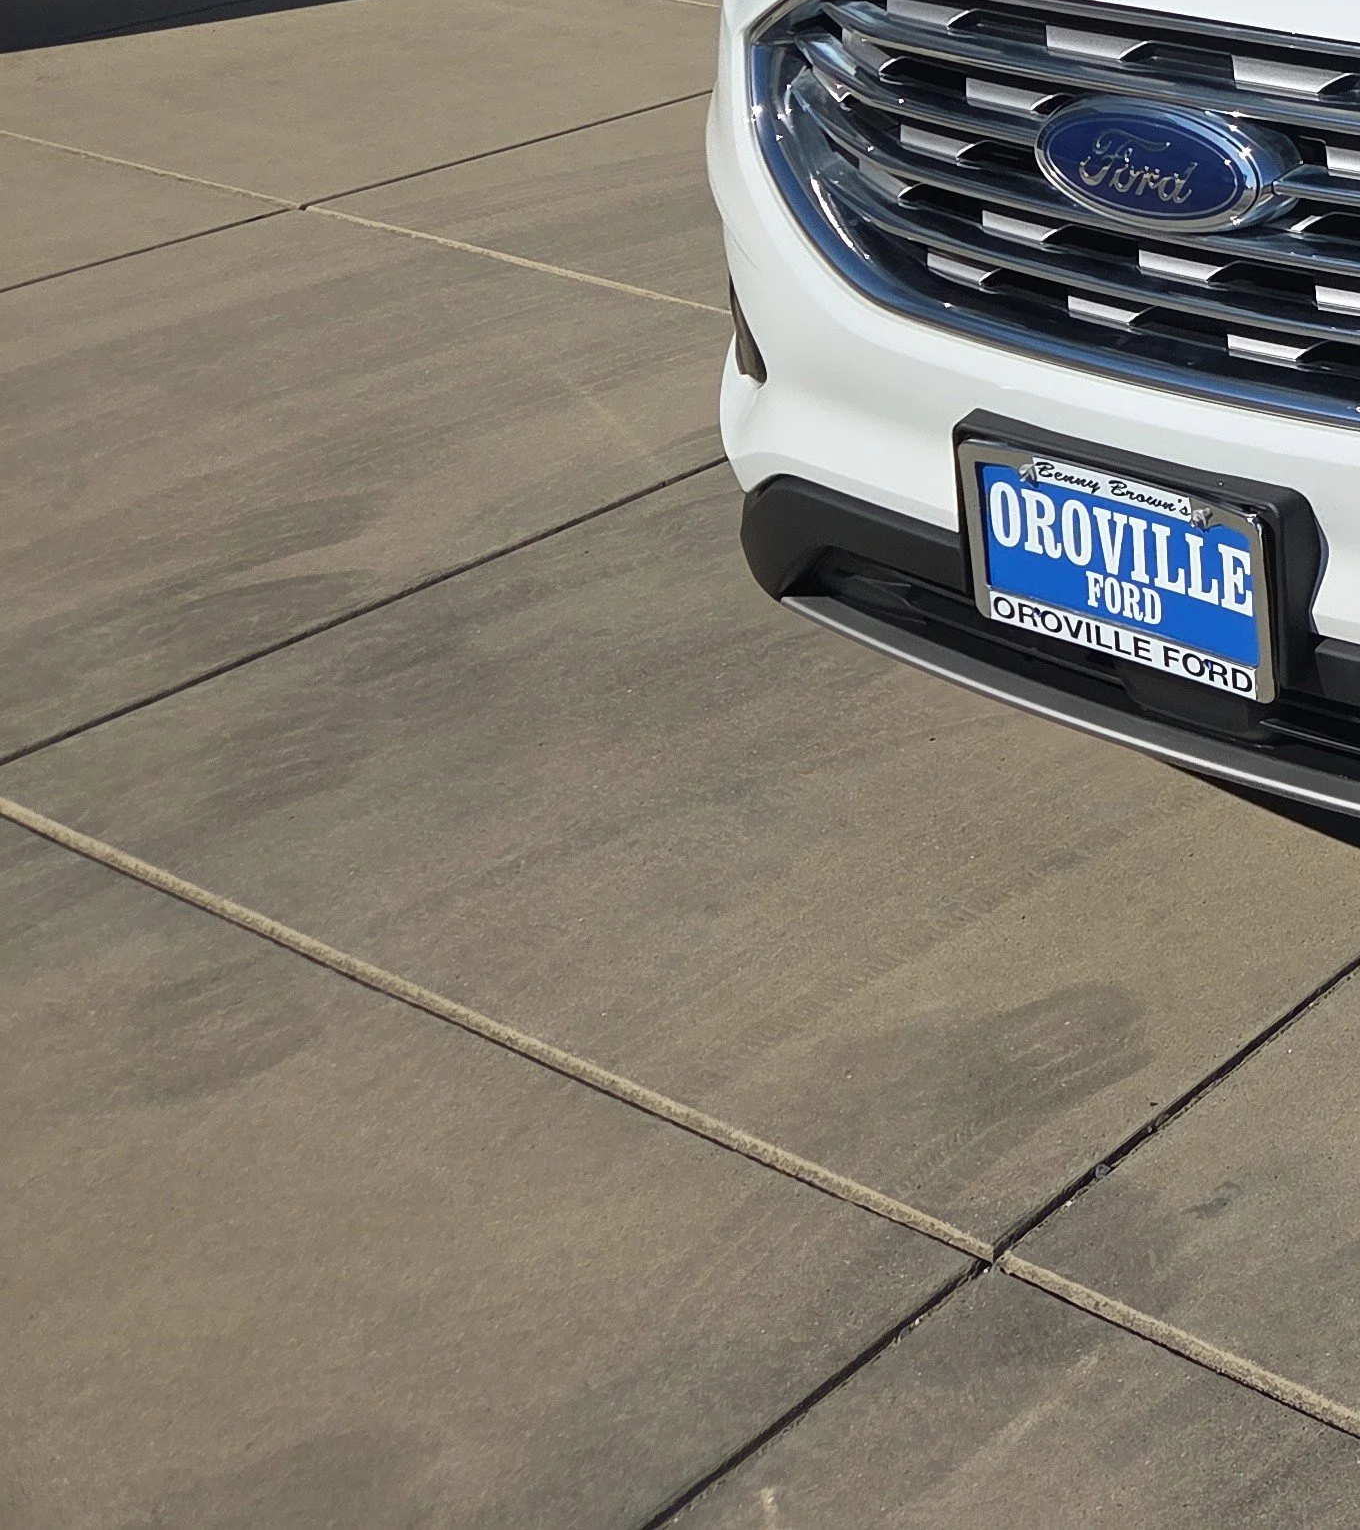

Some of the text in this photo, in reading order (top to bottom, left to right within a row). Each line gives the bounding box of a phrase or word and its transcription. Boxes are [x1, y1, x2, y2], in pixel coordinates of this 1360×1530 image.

[1078, 127, 1199, 205] Ford
[1034, 460, 1192, 517] Benny Brown's
[989, 480, 1254, 618] OROVILLE
[1085, 570, 1163, 625] FORD
[993, 595, 1254, 693] OROVILLE FORD
